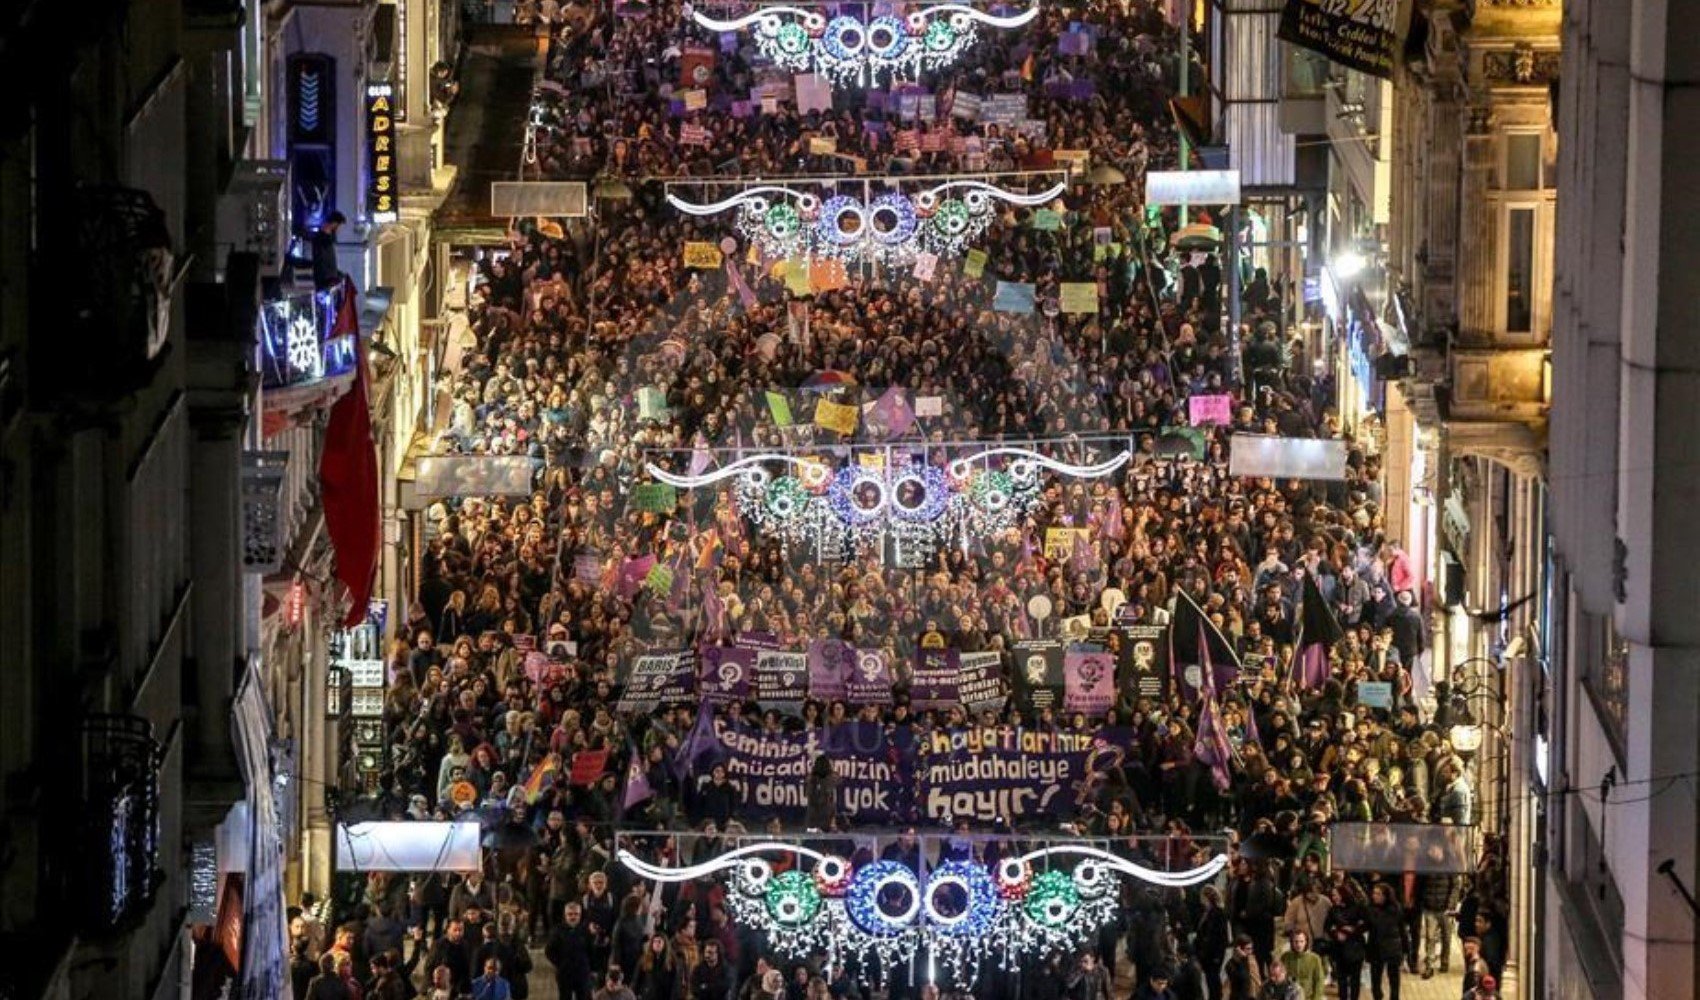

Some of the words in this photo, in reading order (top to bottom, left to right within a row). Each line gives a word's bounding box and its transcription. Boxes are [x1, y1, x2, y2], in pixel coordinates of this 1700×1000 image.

[371, 96, 392, 211] ADRESS
[930, 754, 1070, 785] müdahaleye
[844, 782, 890, 815] yok
